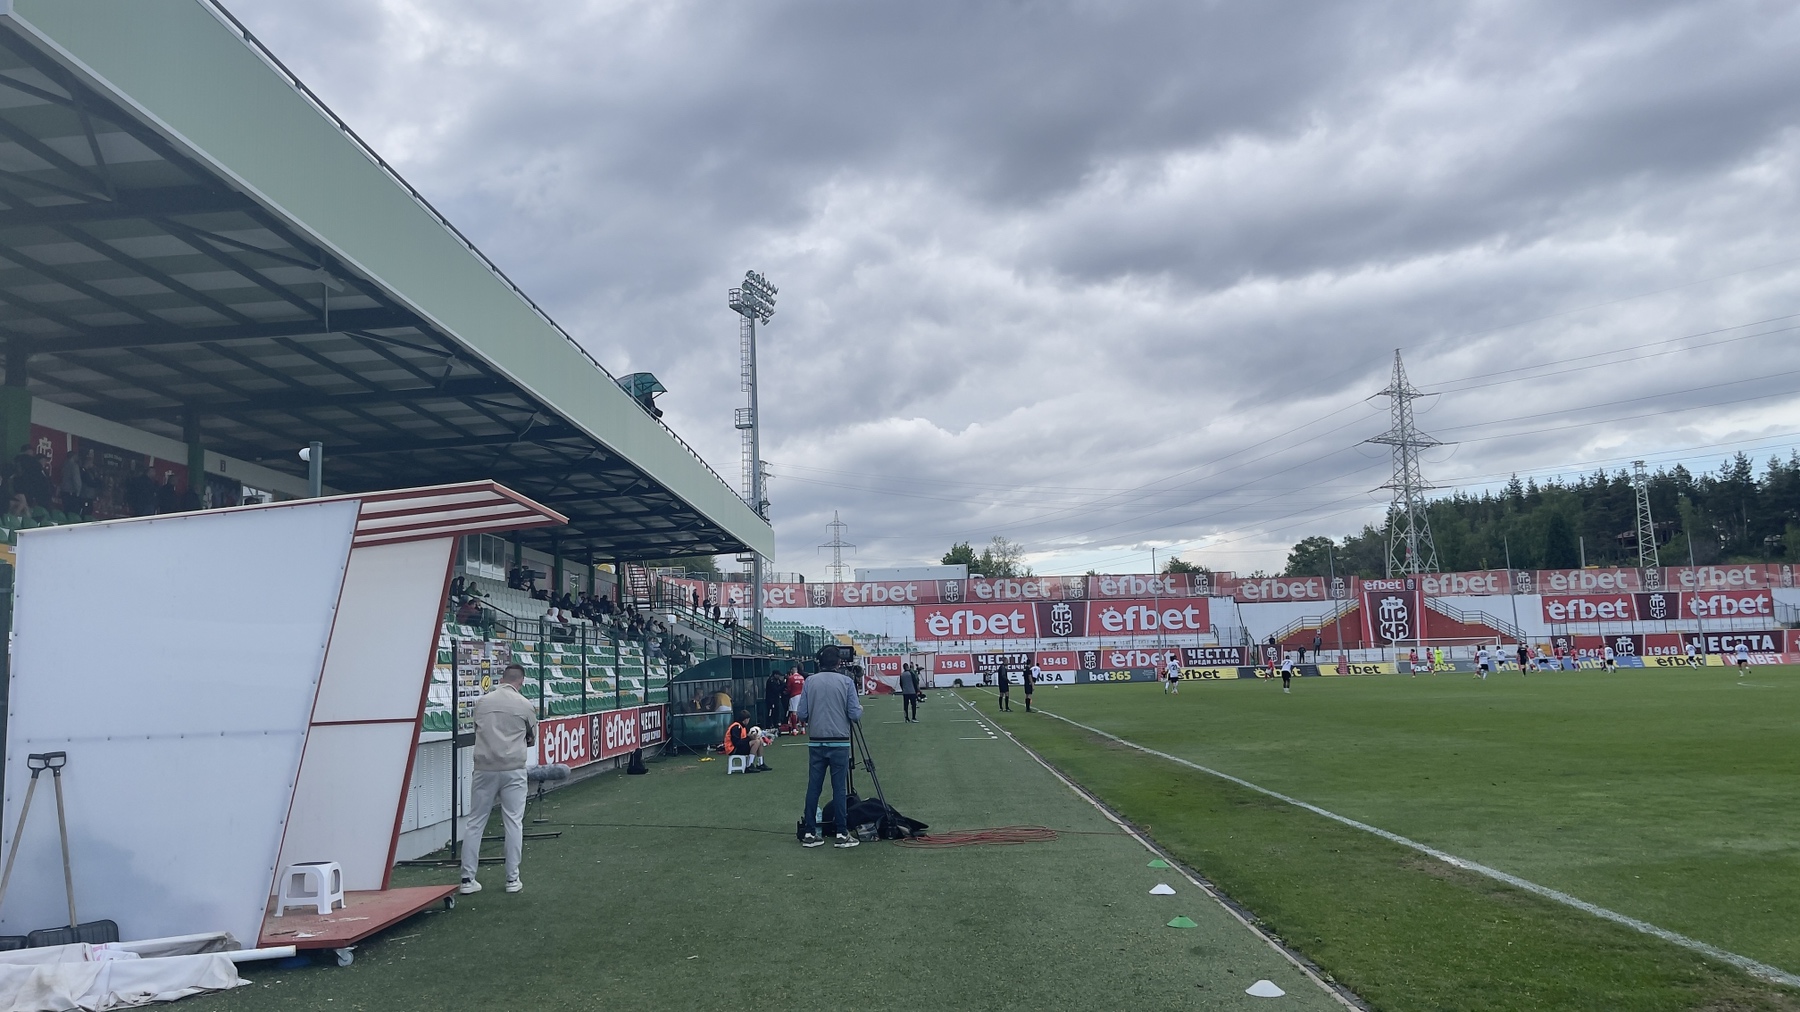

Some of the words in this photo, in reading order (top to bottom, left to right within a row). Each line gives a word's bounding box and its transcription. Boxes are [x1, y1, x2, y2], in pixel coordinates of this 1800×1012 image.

[1100, 575, 1177, 596] efbet
[1363, 580, 1402, 591] efbet
[1422, 573, 1499, 594] efbet
[1550, 569, 1628, 590] efbet
[1680, 565, 1757, 587] efbet
[843, 582, 918, 603] efbet
[975, 578, 1051, 599] efbet
[1242, 578, 1319, 600] efbet
[1549, 597, 1629, 620] efbet
[1690, 593, 1770, 617] efbet
[928, 608, 1026, 636] efbet
[1101, 603, 1200, 632] efbet
[1043, 657, 1068, 665] 1948
[1187, 648, 1240, 658] ЧЕСТТА
[1647, 646, 1678, 656] 1948
[941, 660, 966, 669] 1948
[1089, 670, 1131, 681] bet365
[640, 710, 661, 730] ЧЕСТТА
[606, 712, 636, 750] efbet
[544, 720, 586, 765] efbet
